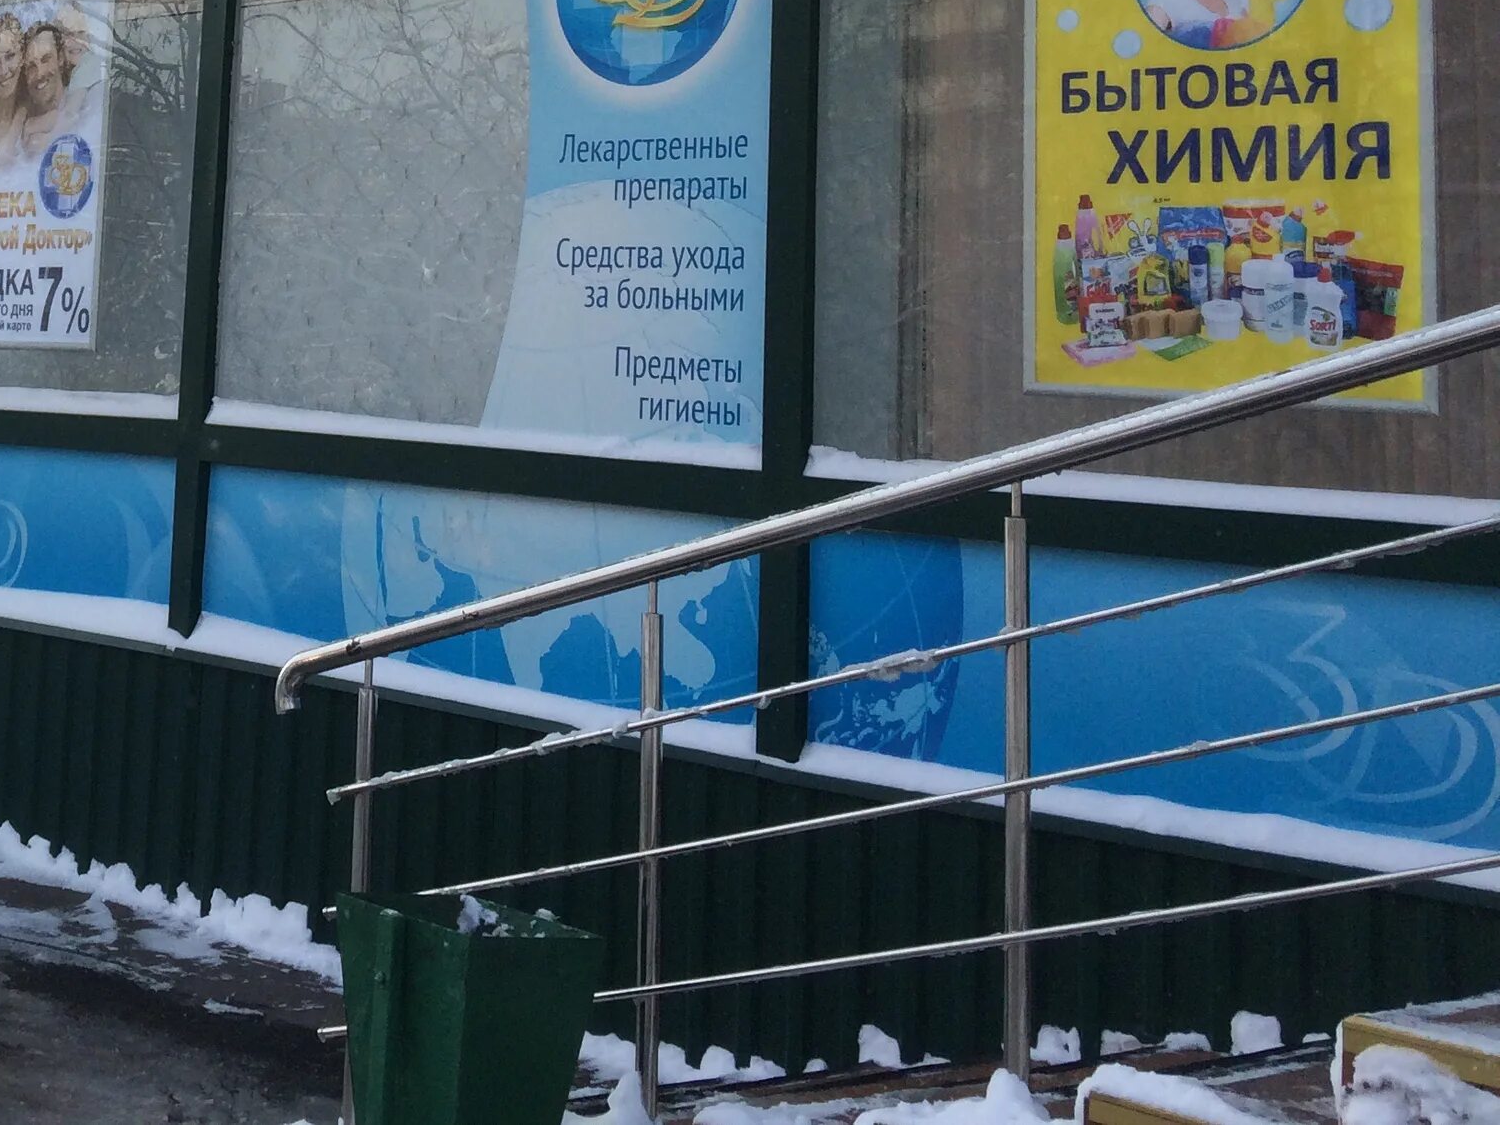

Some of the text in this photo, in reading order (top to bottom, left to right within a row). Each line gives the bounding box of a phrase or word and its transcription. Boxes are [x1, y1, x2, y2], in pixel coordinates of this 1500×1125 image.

[1061, 57, 1339, 114] БЫТОВАЯ
[559, 133, 748, 169] Лекарственные
[1106, 121, 1391, 184] ХИМИЯ
[614, 175, 747, 208] препараты
[22, 224, 93, 255] Доктор»
[556, 237, 745, 277] Средства ухода
[38, 266, 90, 334] 7%
[584, 278, 745, 312] за больными
[615, 346, 742, 386] Предметы
[638, 396, 741, 426] гигиены
